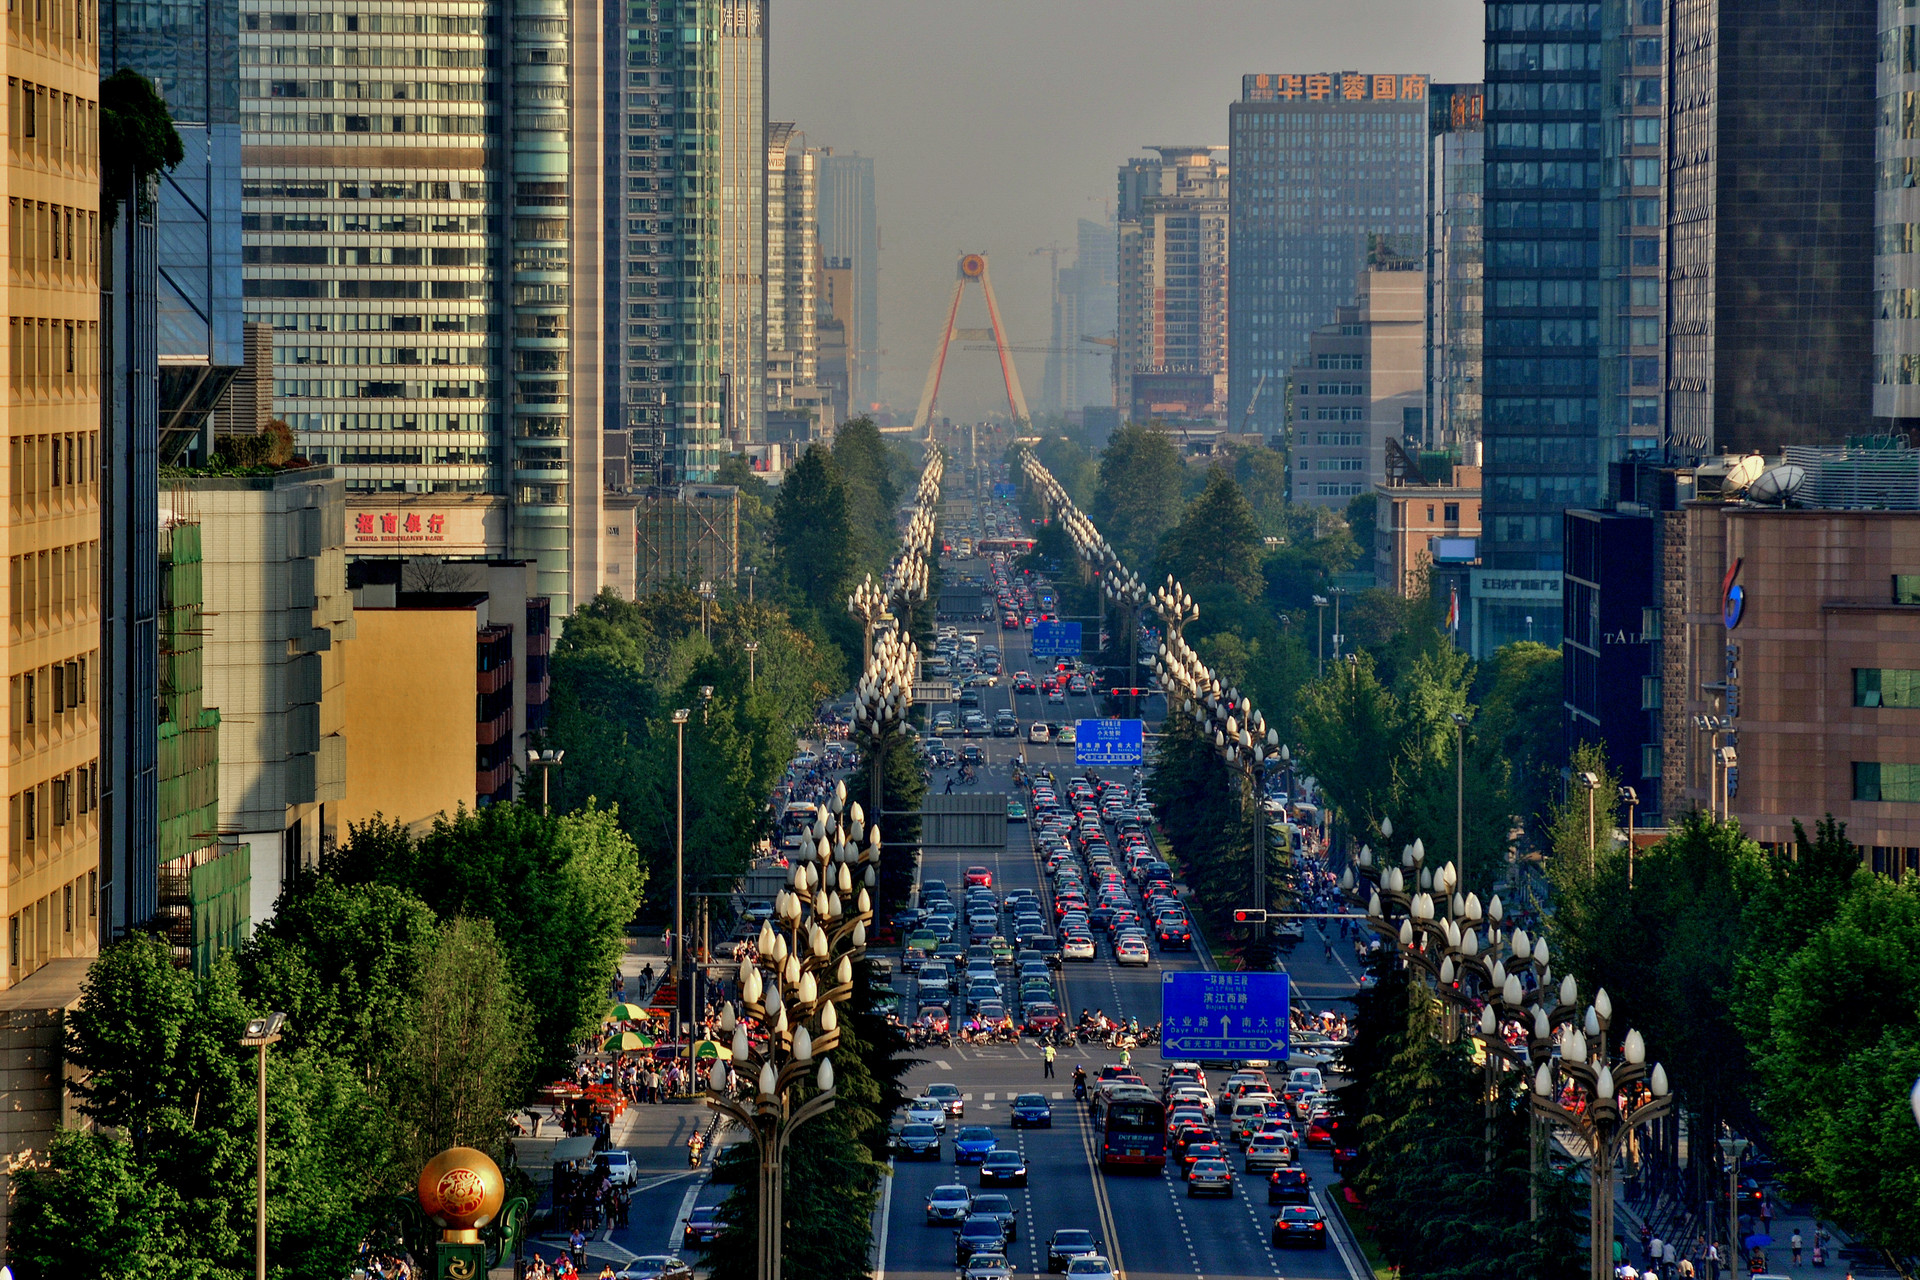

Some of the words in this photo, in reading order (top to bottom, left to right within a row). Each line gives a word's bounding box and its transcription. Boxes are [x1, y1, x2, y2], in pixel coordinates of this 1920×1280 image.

[355, 512, 444, 534] 招商银行
[1204, 975, 1248, 986] 一环路南三段
[1204, 993, 1248, 1004] 滨江西路
[1166, 1016, 1209, 1027] 大业路
[1242, 1016, 1285, 1028] 南大街
